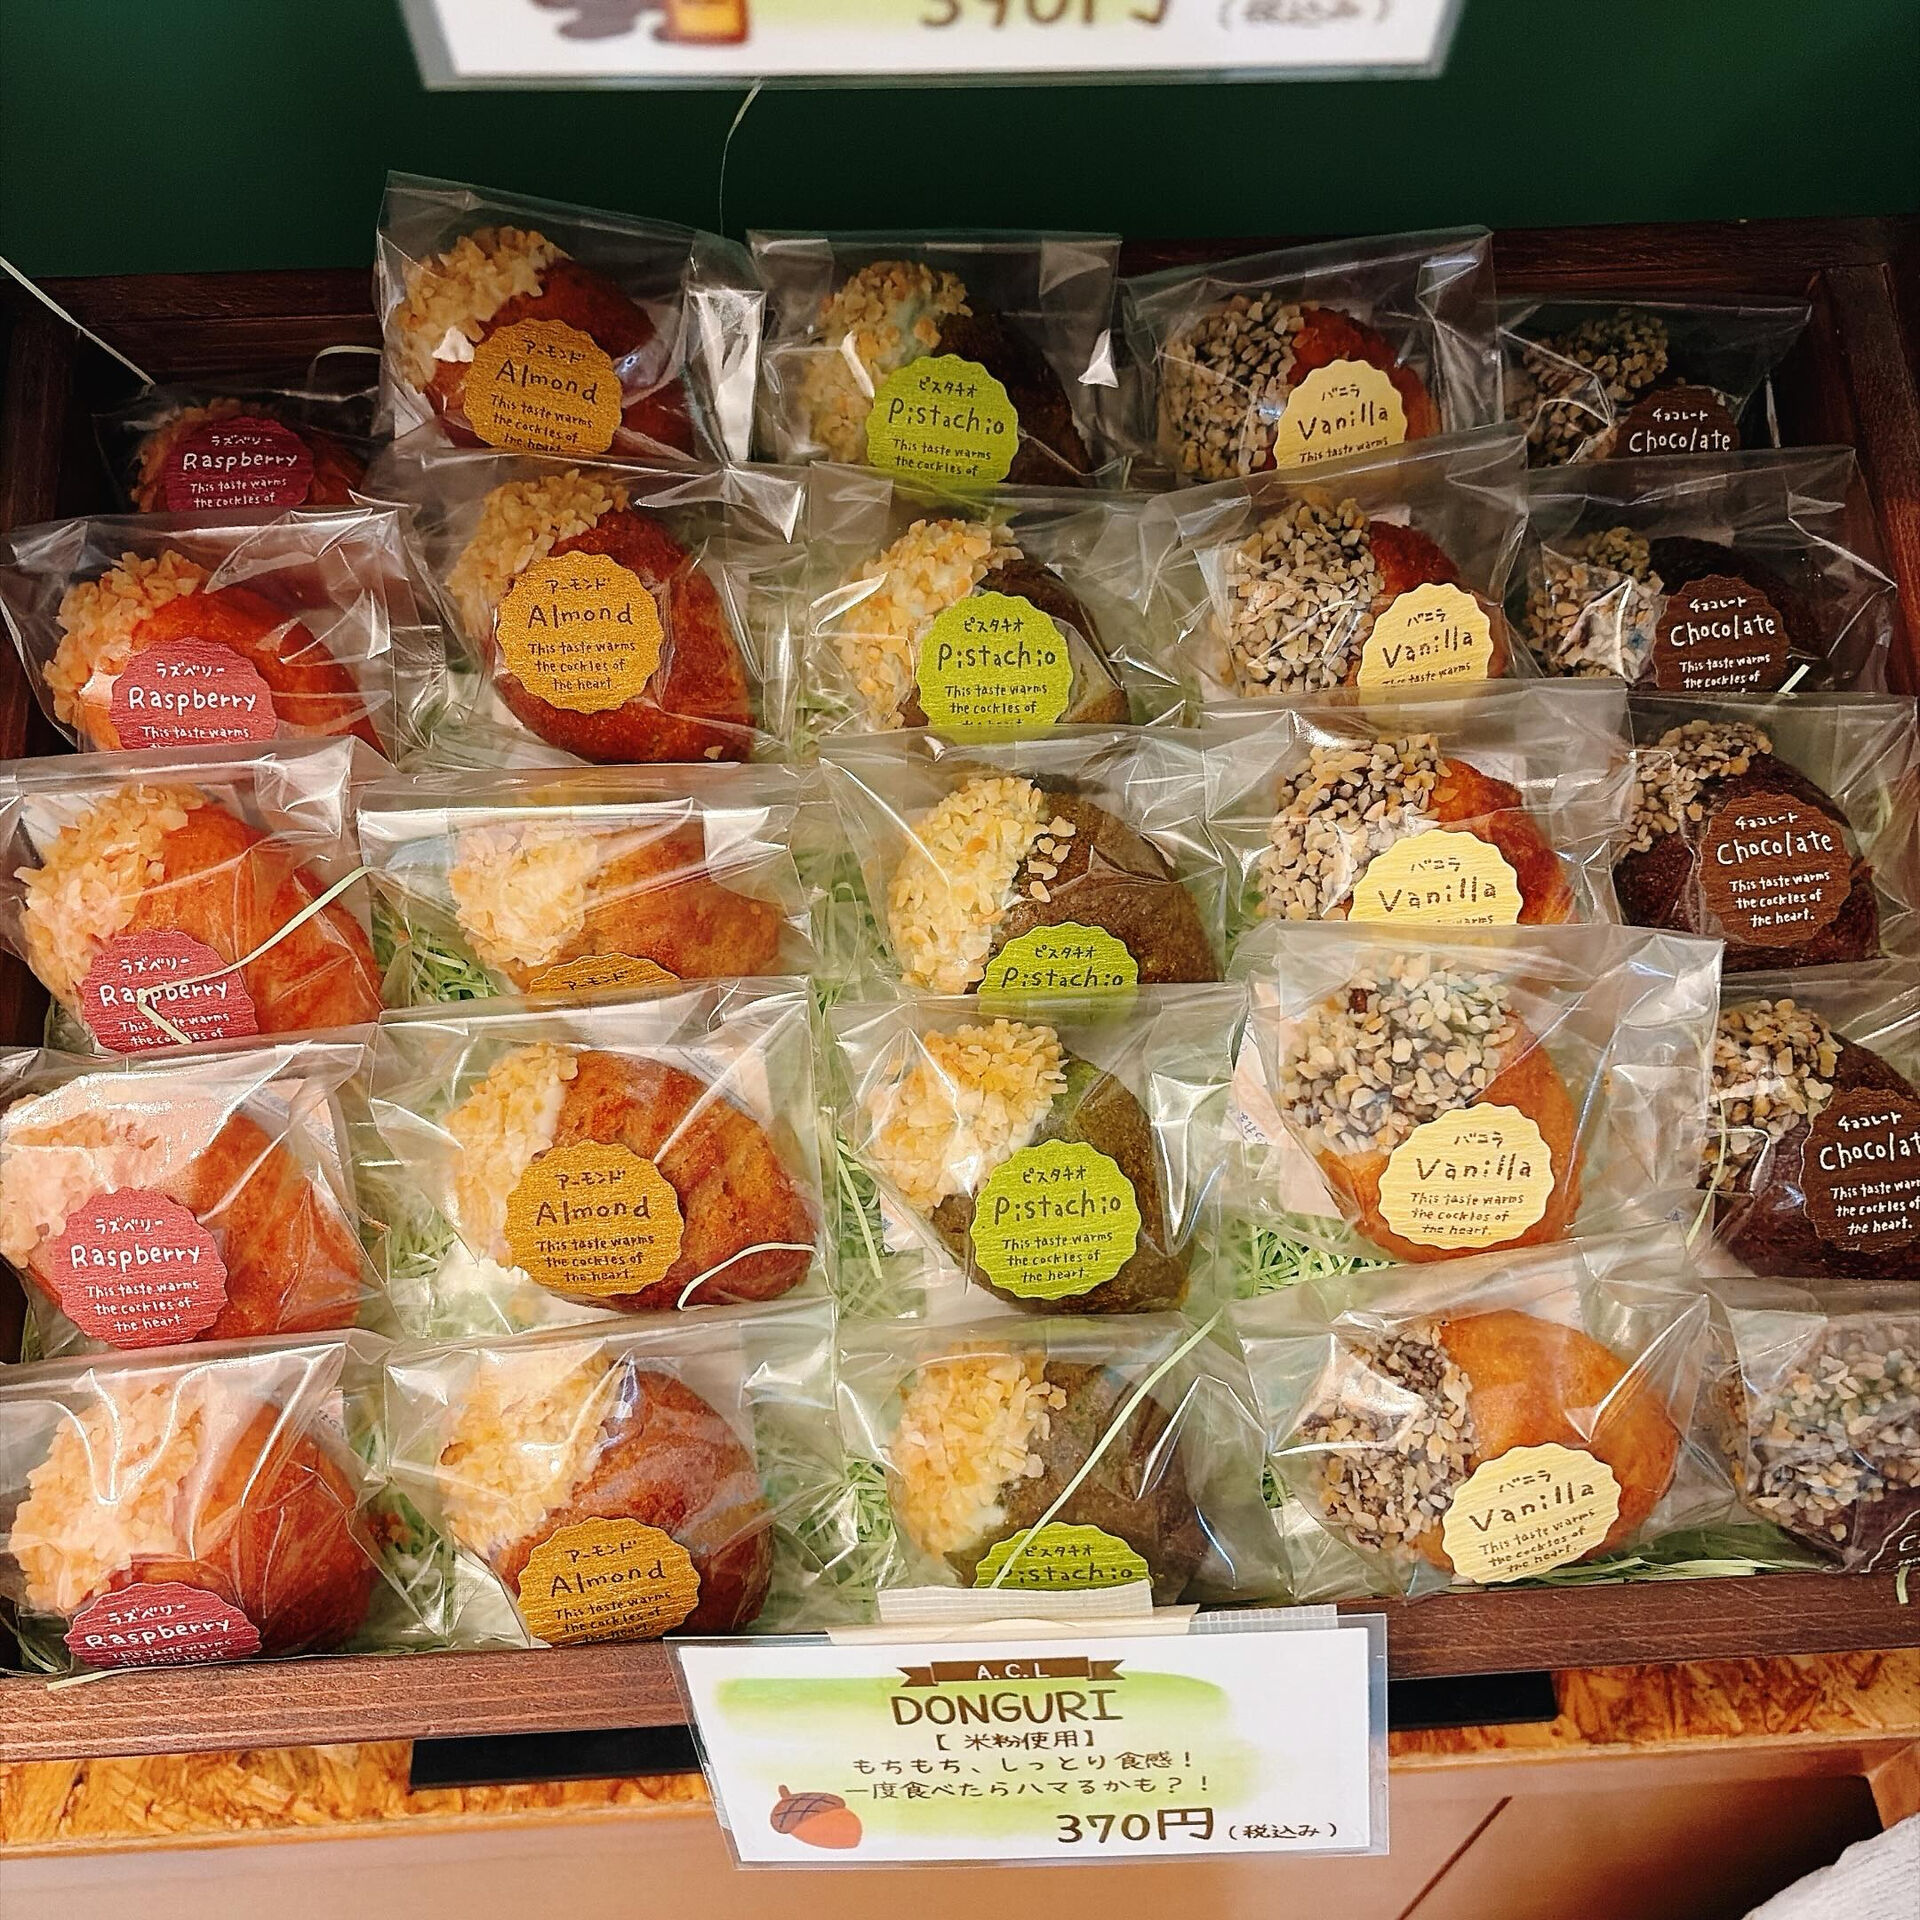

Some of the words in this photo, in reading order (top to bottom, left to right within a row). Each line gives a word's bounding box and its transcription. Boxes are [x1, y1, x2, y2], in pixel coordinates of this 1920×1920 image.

[523, 339, 586, 363] アーモンド
[495, 359, 598, 405] Almond
[920, 377, 977, 398] ピスタチオ
[1322, 384, 1360, 401] バニラ
[491, 394, 516, 410] This
[521, 401, 551, 419] taste
[555, 412, 593, 428] warms
[888, 398, 1004, 435] Pistachio
[1298, 401, 1388, 440] Vanilla
[1653, 408, 1708, 422] チョコレート
[493, 413, 512, 427] the
[515, 419, 565, 439] cockles
[566, 432, 578, 444] of
[211, 436, 272, 446] ラズベリー
[892, 438, 916, 450] This
[922, 442, 950, 456] taste
[954, 449, 991, 460] warms
[1629, 428, 1731, 452] Chocolate
[1300, 453, 1322, 463] This
[1327, 444, 1352, 458] taste
[1357, 437, 1388, 451] warms
[183, 452, 297, 472] Raspberry
[895, 456, 914, 467] the
[918, 461, 962, 475] cockles
[966, 466, 978, 476] of
[545, 578, 610, 593] アーモンド
[1690, 597, 1747, 612] チョコレート
[528, 603, 633, 628] Almond
[964, 617, 1024, 632] ピスタチオ
[1408, 609, 1445, 627] バニラ
[1671, 615, 1775, 646] Chocolate
[528, 643, 555, 655] This
[559, 642, 592, 654] taste
[596, 642, 635, 651] warms
[938, 641, 1055, 671] Pistachio
[1383, 626, 1472, 668] Vanilla
[157, 662, 224, 678] ラズベリー
[535, 660, 555, 672] the
[560, 661, 608, 672] cockles
[613, 659, 625, 670] of
[1679, 661, 1703, 673] This
[1707, 658, 1733, 670] taste
[1736, 654, 1770, 665] warms
[1683, 677, 1701, 688] the
[1705, 674, 1745, 687] cockles
[1749, 670, 1760, 682] of
[945, 685, 971, 698] This
[975, 684, 1006, 697] taste
[1010, 684, 1047, 693] warms
[129, 686, 256, 716] Raspberry
[951, 703, 969, 714] the
[974, 703, 1020, 714] cockles
[1025, 701, 1038, 713] of
[140, 726, 169, 739] This
[175, 726, 205, 739] taste
[209, 728, 249, 738] warms
[1735, 812, 1798, 830] チョコレート
[1717, 832, 1833, 865] Chocolate
[1411, 857, 1460, 872] バニラ
[1729, 880, 1756, 892] This
[1759, 875, 1790, 889] taste
[1792, 872, 1830, 884] warms
[1379, 877, 1496, 912] Vanilla
[1736, 898, 1757, 909] the
[1760, 893, 1806, 907] cockles
[1810, 889, 1822, 902] of
[1751, 915, 1771, 927] the
[1776, 908, 1815, 924] heart.
[1035, 945, 1096, 958] ピスタチオ
[120, 956, 190, 974] ラズベリー
[1002, 967, 1123, 988] Pistachio
[1838, 1112, 1901, 1132] チョコレート
[1454, 1131, 1503, 1148] バニラ
[1023, 1166, 1086, 1183] ピスタチオ
[1416, 1154, 1531, 1180] Vanilla
[555, 1170, 626, 1190] アーモンド
[1411, 1193, 1439, 1204] This
[1443, 1194, 1478, 1206] taste
[1483, 1195, 1523, 1204] warms
[1830, 1188, 1857, 1200] This
[1860, 1183, 1891, 1197] taste
[536, 1196, 650, 1226] Almond
[995, 1189, 1121, 1225] Pistachio
[1411, 1209, 1433, 1219] the
[1438, 1212, 1489, 1220] cockles
[1495, 1211, 1509, 1221] of
[1836, 1205, 1856, 1217] the
[1859, 1201, 1906, 1214] cockles
[96, 1217, 164, 1234] ラズベリー
[1422, 1225, 1443, 1233] the
[1847, 1223, 1868, 1235] the
[1873, 1216, 1913, 1233] heart.
[536, 1241, 566, 1252] This
[572, 1239, 607, 1250] taste
[610, 1235, 654, 1246] warms
[1002, 1239, 1030, 1250] This
[1035, 1235, 1067, 1249] taste
[1072, 1232, 1112, 1244] warms
[71, 1243, 199, 1273] Raspberry
[546, 1257, 567, 1267] the
[572, 1256, 625, 1266] cockles
[630, 1252, 643, 1264] of
[1007, 1255, 1028, 1266] the
[1033, 1253, 1082, 1265] cockles
[1088, 1250, 1099, 1261] of
[564, 1272, 585, 1282] the
[1022, 1272, 1042, 1282] the
[86, 1285, 114, 1298] This
[118, 1284, 152, 1297] taste
[157, 1280, 199, 1293] warms
[94, 1303, 117, 1316] the
[121, 1301, 174, 1314] cockles
[178, 1297, 193, 1308] of
[114, 1321, 138, 1332] the
[1499, 1470, 1550, 1493] バニラ
[1469, 1482, 1594, 1531] Vanilla
[1479, 1540, 1510, 1555] This
[1513, 1526, 1549, 1546] taste
[1553, 1509, 1595, 1531] warms
[566, 1540, 636, 1562] アーモンド
[1024, 1545, 1094, 1557] ピスタチオ
[1488, 1555, 1511, 1567] the
[1516, 1535, 1566, 1558] cockles
[1572, 1527, 1586, 1537] of
[551, 1560, 666, 1597] Almond
[108, 1605, 186, 1625] ラズベリー
[554, 1607, 583, 1620] This
[589, 1601, 623, 1614] taste
[629, 1593, 670, 1606] warms
[564, 1621, 586, 1632] the
[649, 1607, 662, 1617] of
[85, 1620, 230, 1648] Raspberry
[977, 1663, 1049, 1679] A.C.L
[891, 1690, 1123, 1725] DONGURI
[1056, 1808, 1213, 1843] 370円
